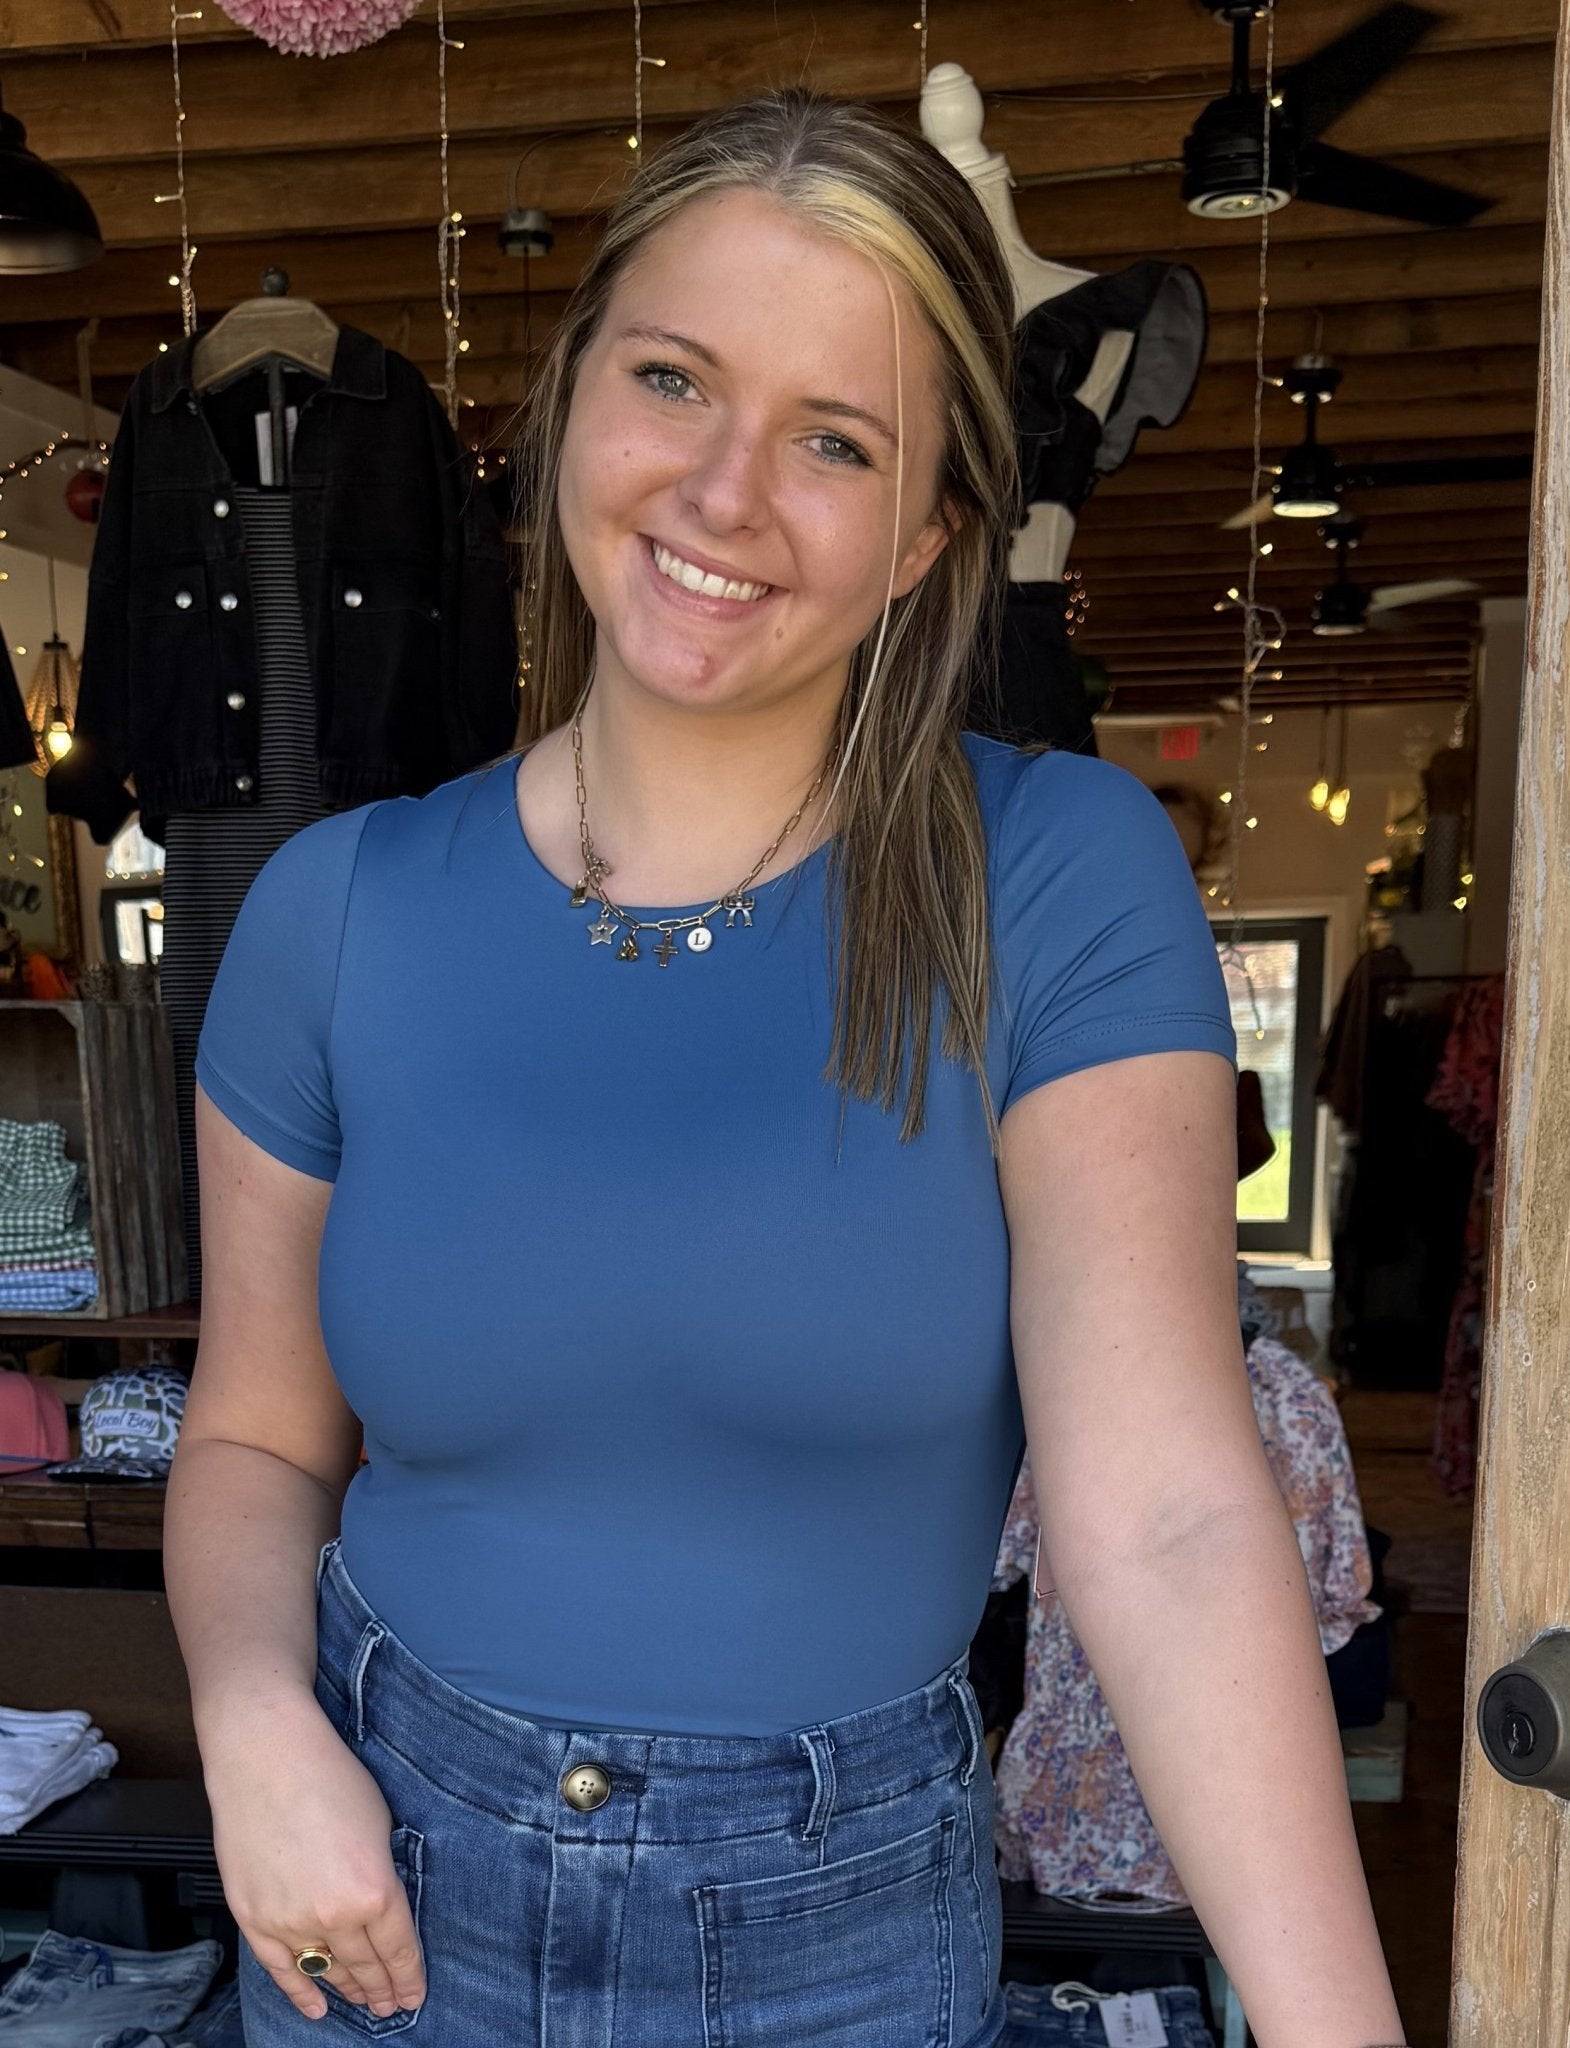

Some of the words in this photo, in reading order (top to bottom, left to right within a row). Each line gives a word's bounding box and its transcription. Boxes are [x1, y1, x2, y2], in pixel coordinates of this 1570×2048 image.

[694, 933, 705, 945] L
[95, 1410, 127, 1428] Local
[127, 1412, 158, 1435] Boy
